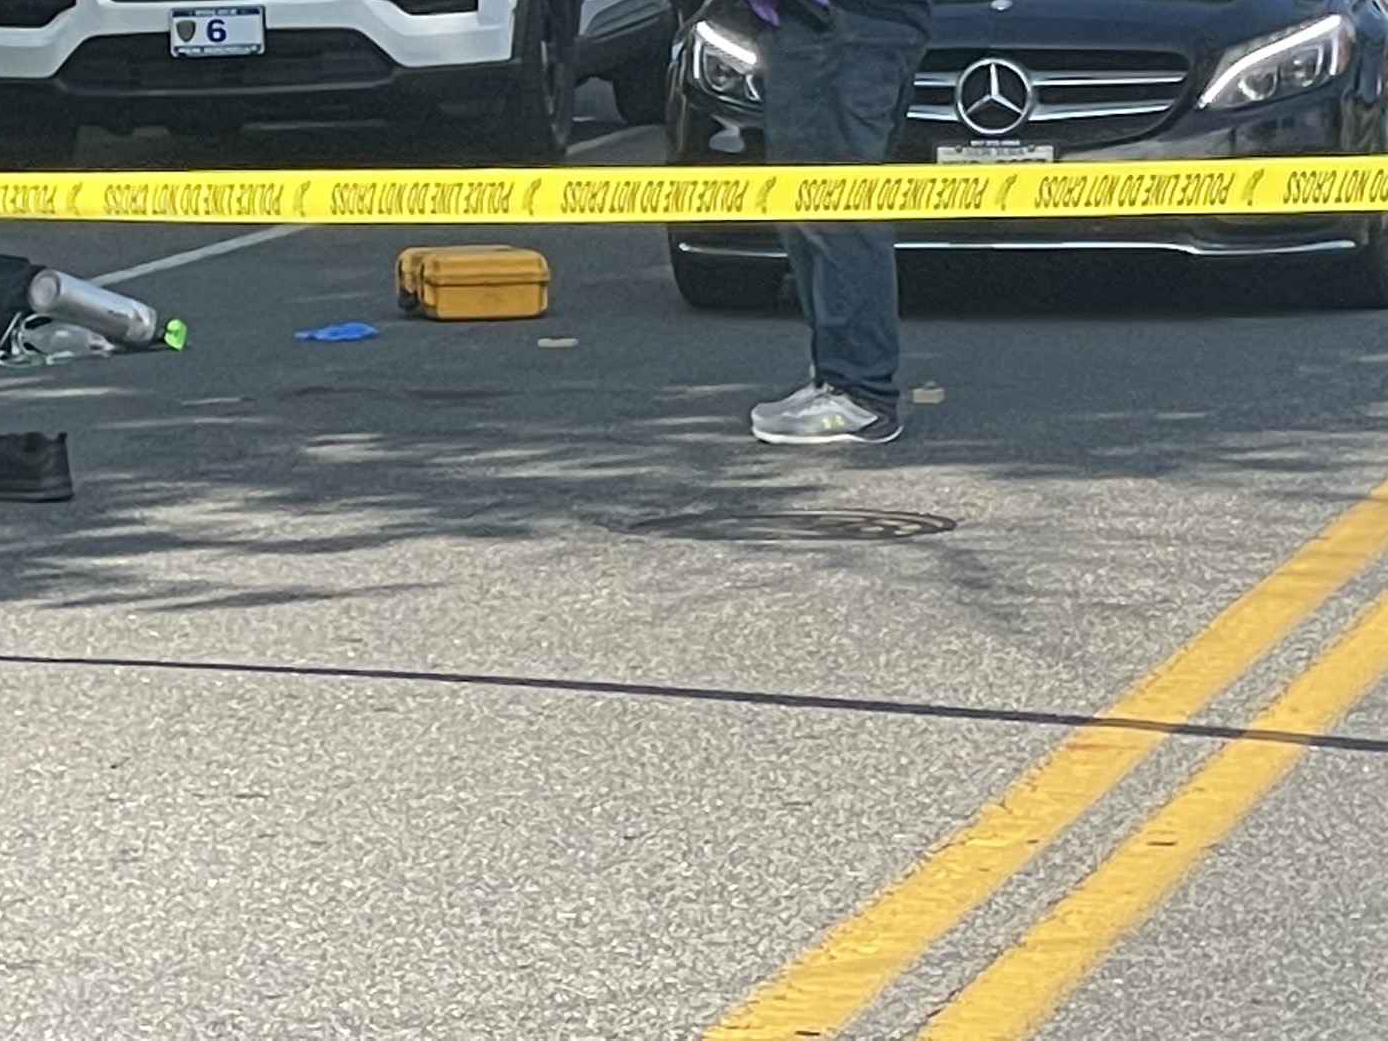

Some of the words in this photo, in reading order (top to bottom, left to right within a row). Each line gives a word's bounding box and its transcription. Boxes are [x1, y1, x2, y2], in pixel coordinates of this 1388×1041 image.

[206, 18, 227, 43] 6
[330, 182, 377, 215] CROSS
[378, 182, 407, 215] NOT
[407, 181, 430, 215] DO
[430, 182, 464, 214] LINE
[463, 181, 515, 214] POLICE
[561, 181, 610, 214] CROSS
[609, 181, 641, 213] NOT
[641, 181, 664, 213] DO
[663, 180, 698, 213] LINE
[696, 179, 750, 213] POLICE
[795, 179, 847, 212] CROSS
[843, 178, 880, 211] NOT
[876, 177, 903, 211] DO
[899, 177, 937, 211] LINE
[933, 177, 989, 210] POLICE
[1034, 175, 1088, 209] CROSS
[1084, 175, 1121, 207] NOT
[1118, 174, 1145, 207] DO
[1141, 173, 1181, 207] LINE
[1176, 172, 1236, 206] POLICE
[1283, 170, 1337, 204] CROSS
[1334, 169, 1372, 203] NOT
